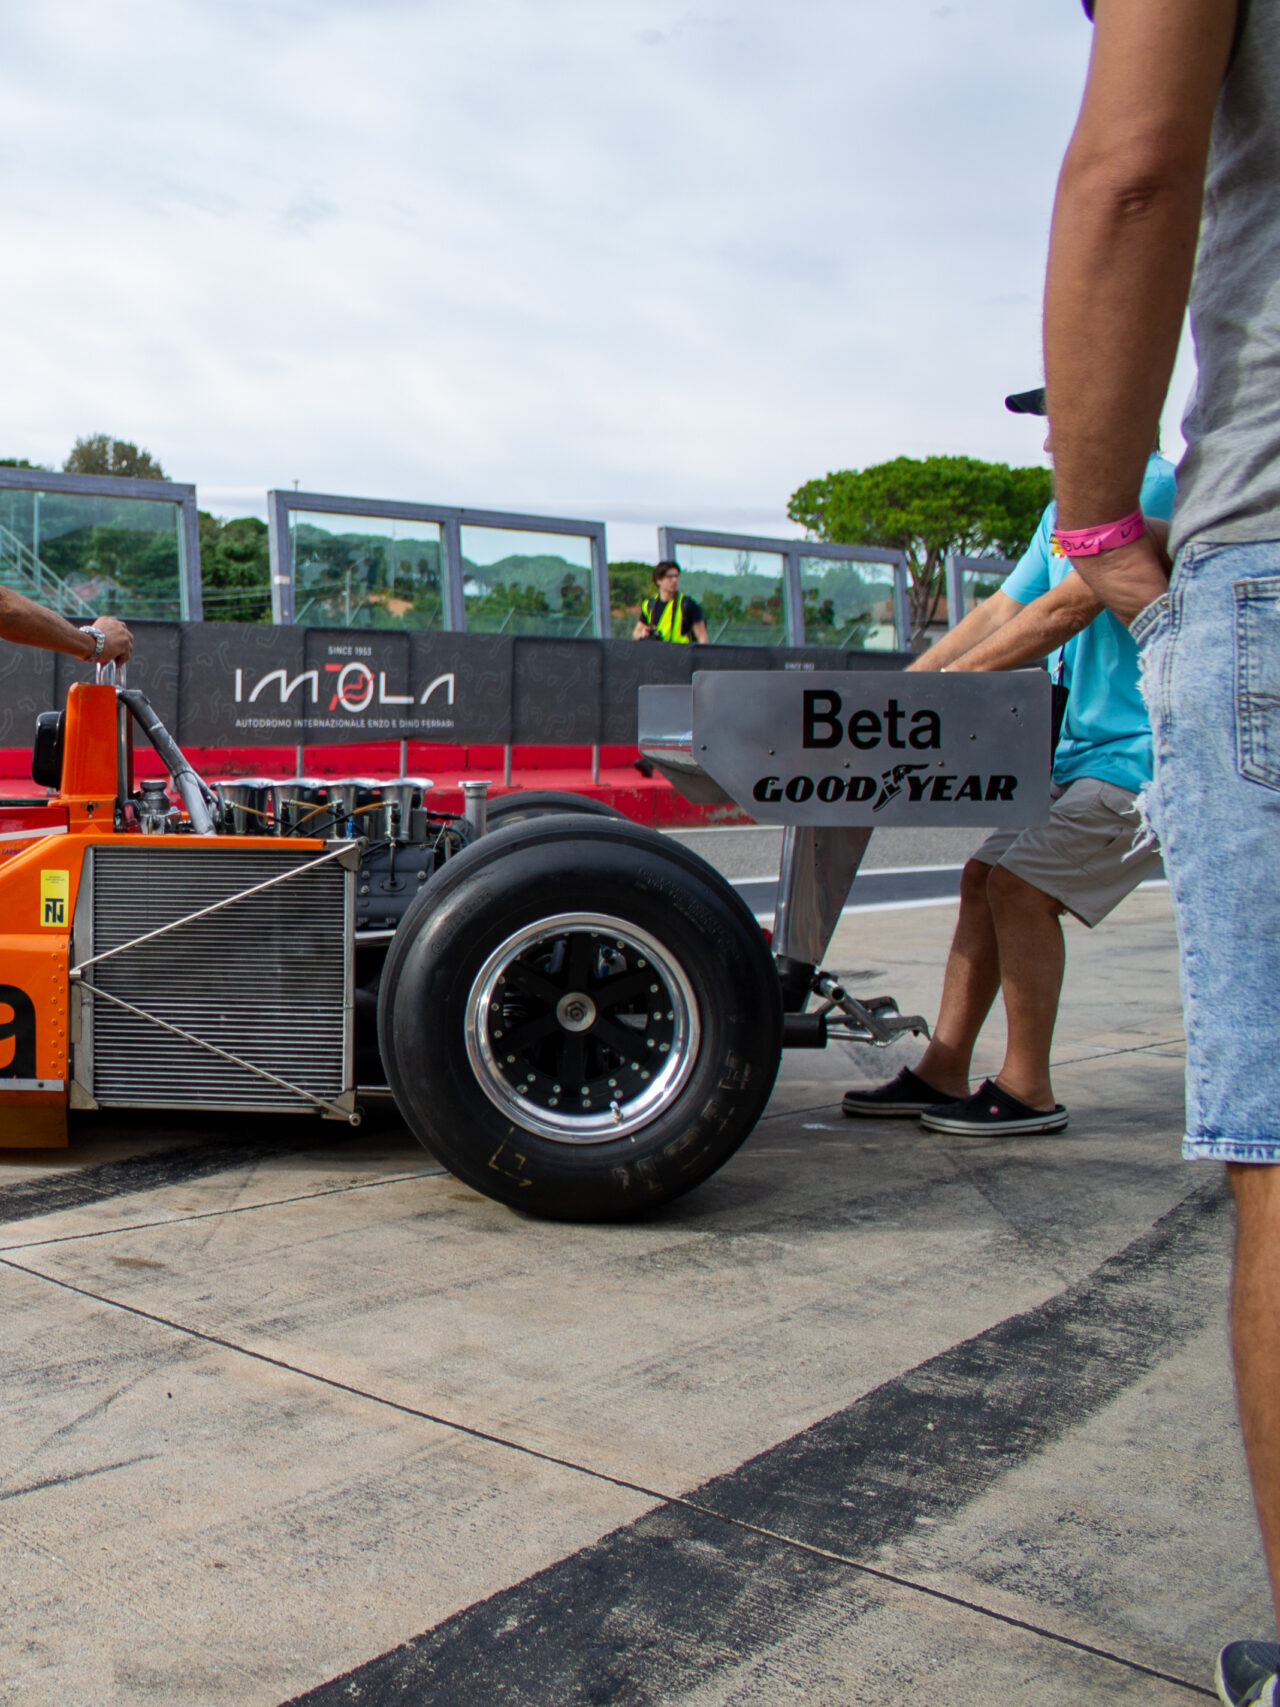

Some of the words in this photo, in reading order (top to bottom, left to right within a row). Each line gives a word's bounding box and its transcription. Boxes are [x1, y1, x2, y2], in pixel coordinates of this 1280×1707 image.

[328, 646, 352, 656] SINCE
[235, 718, 292, 729] AUTODROMO
[294, 718, 366, 729] INTERNAZIONALE
[367, 719, 390, 729] ENZO
[391, 719, 398, 729] E
[399, 719, 420, 729] DINO
[421, 719, 455, 729] FERRARI
[802, 689, 942, 750] Beta
